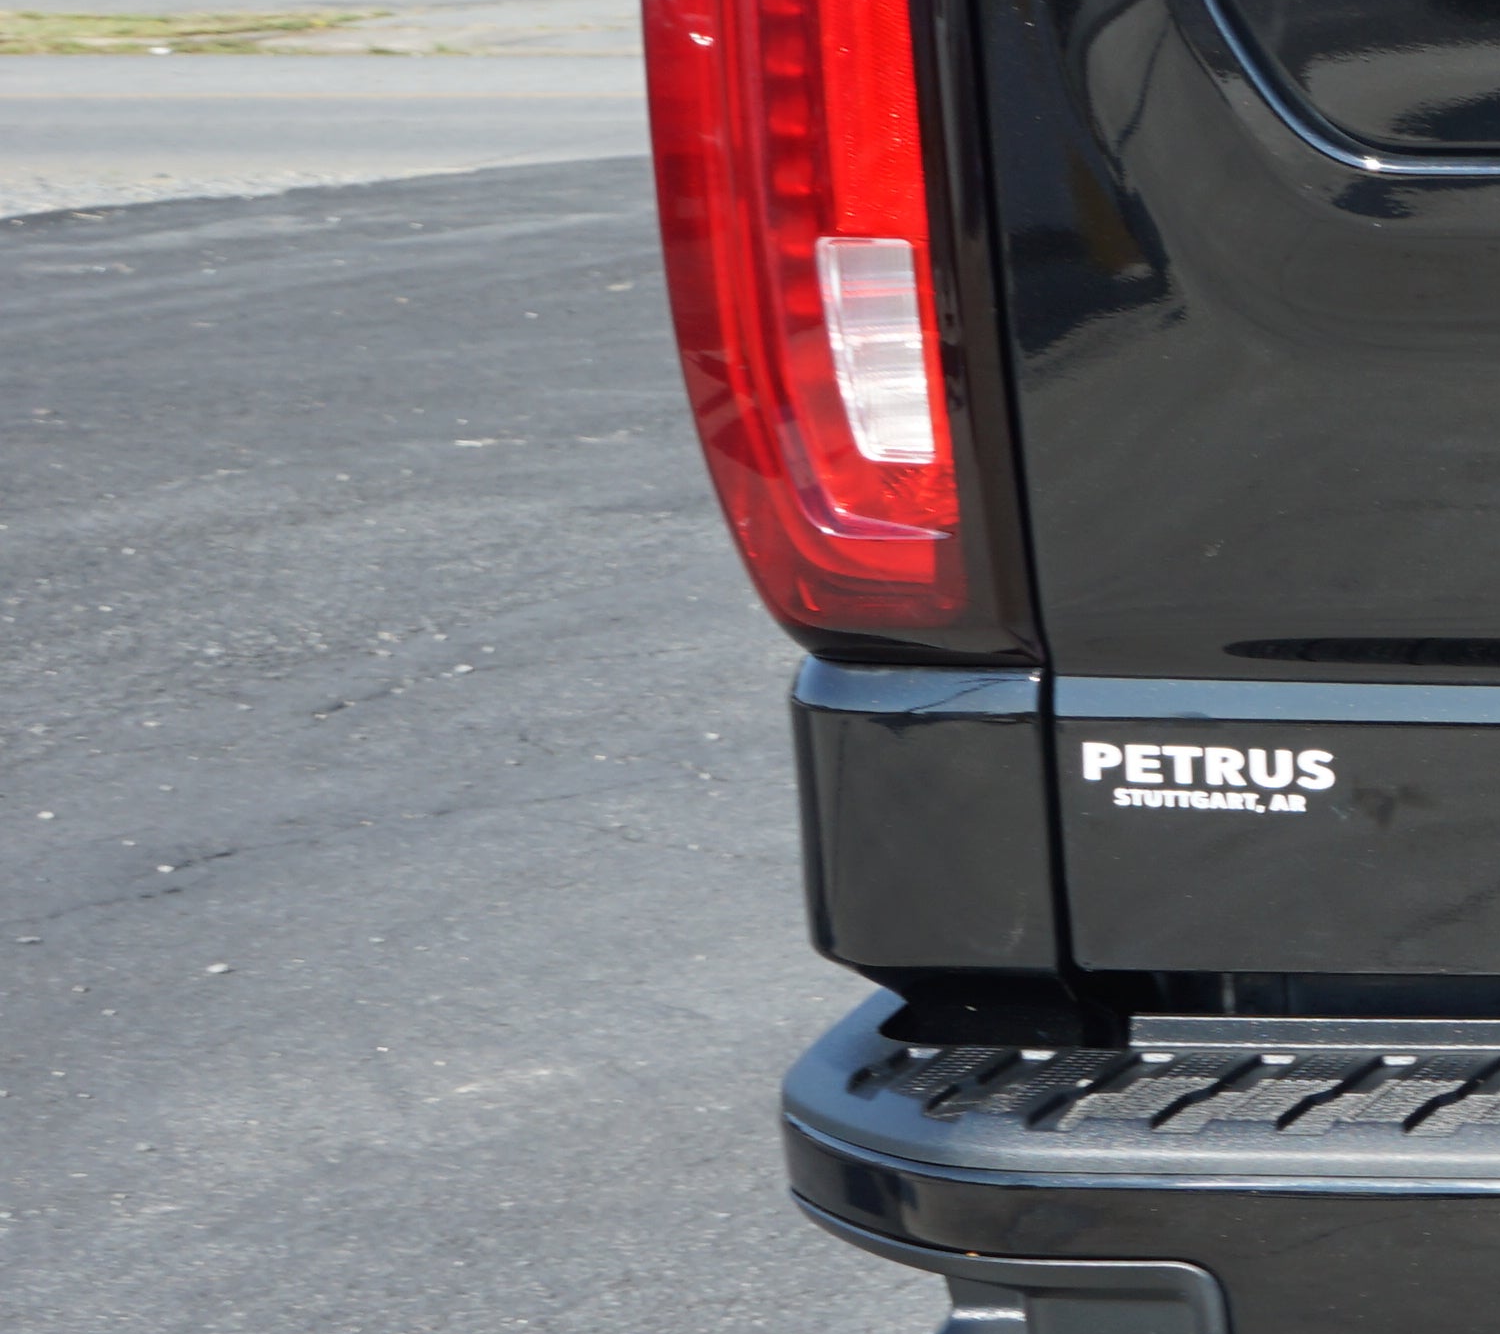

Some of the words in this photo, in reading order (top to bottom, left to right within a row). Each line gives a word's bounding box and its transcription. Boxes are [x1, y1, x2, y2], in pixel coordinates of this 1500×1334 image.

[1081, 741, 1336, 790] PETRUS
[1112, 787, 1266, 814] STUTTGART,
[1268, 793, 1307, 813] AR
